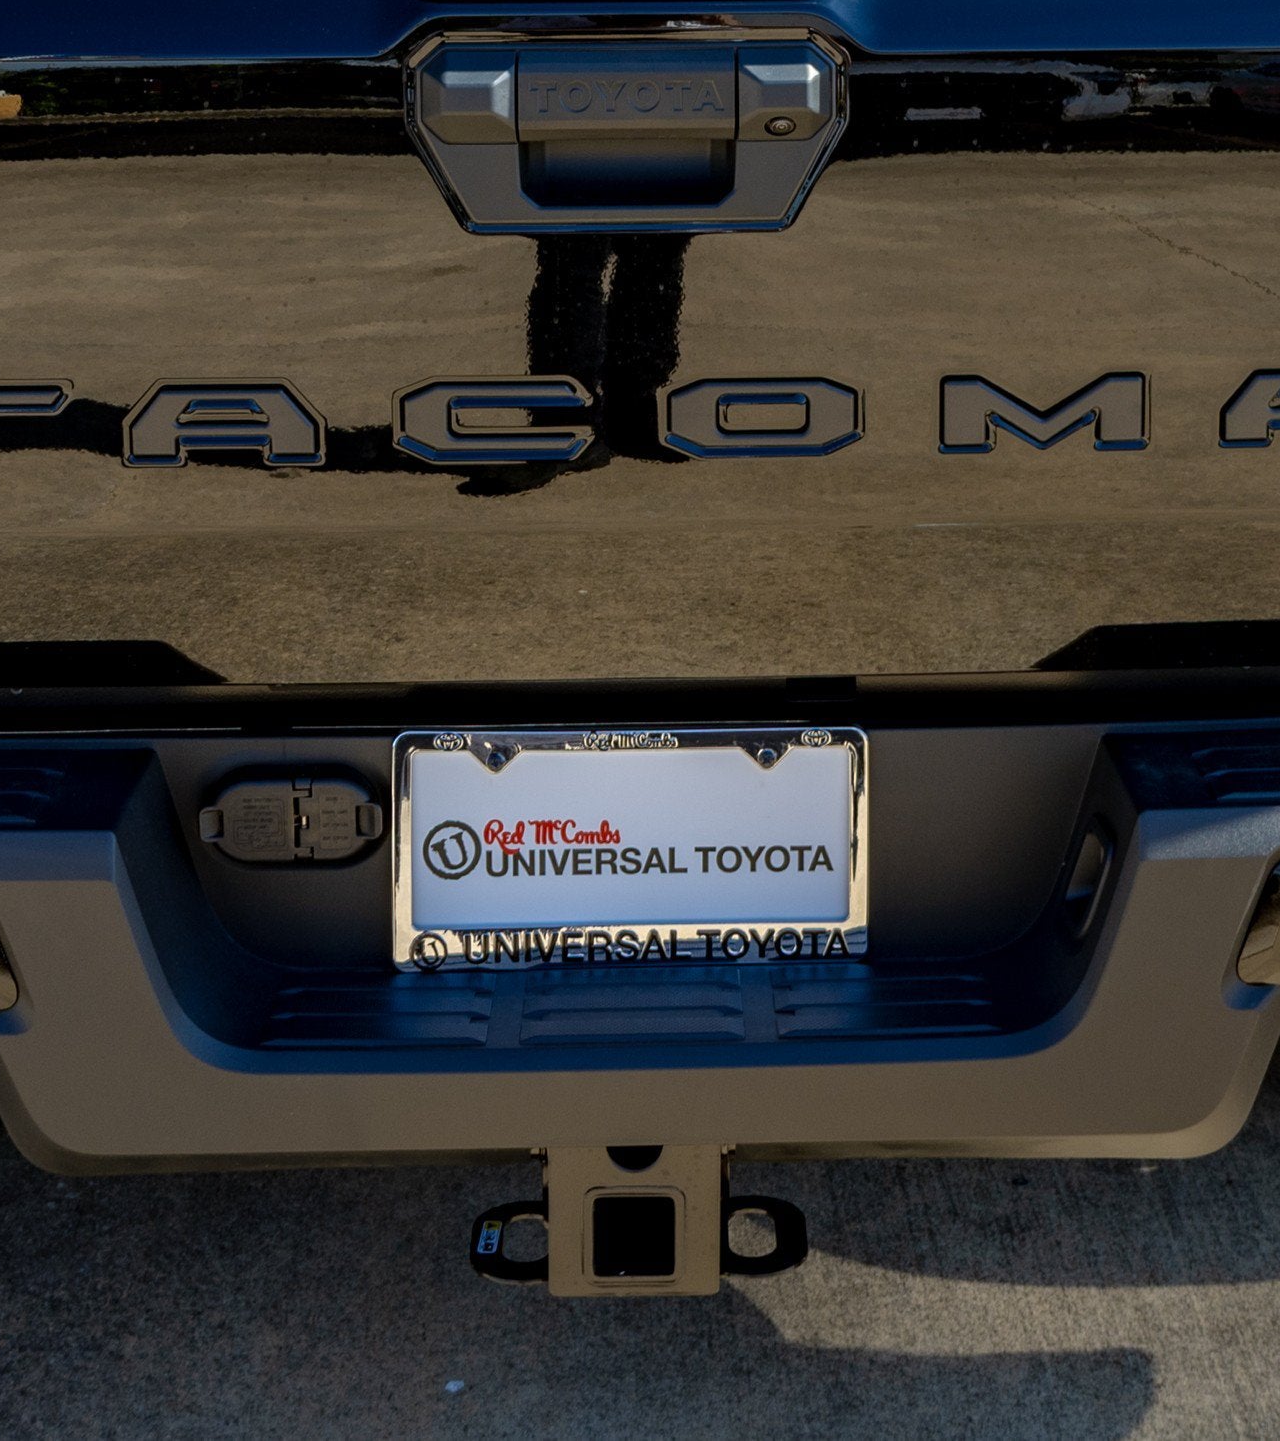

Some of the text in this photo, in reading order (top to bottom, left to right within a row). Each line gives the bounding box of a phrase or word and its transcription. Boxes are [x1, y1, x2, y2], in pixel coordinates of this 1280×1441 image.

[529, 78, 724, 114] TOYOTA
[483, 819, 621, 855] Red McCombs
[486, 847, 688, 877] UNIVERSAL
[694, 845, 834, 873] TOYOTA
[463, 928, 692, 964] UNIVERSAL
[696, 927, 850, 960] TOYOTA
